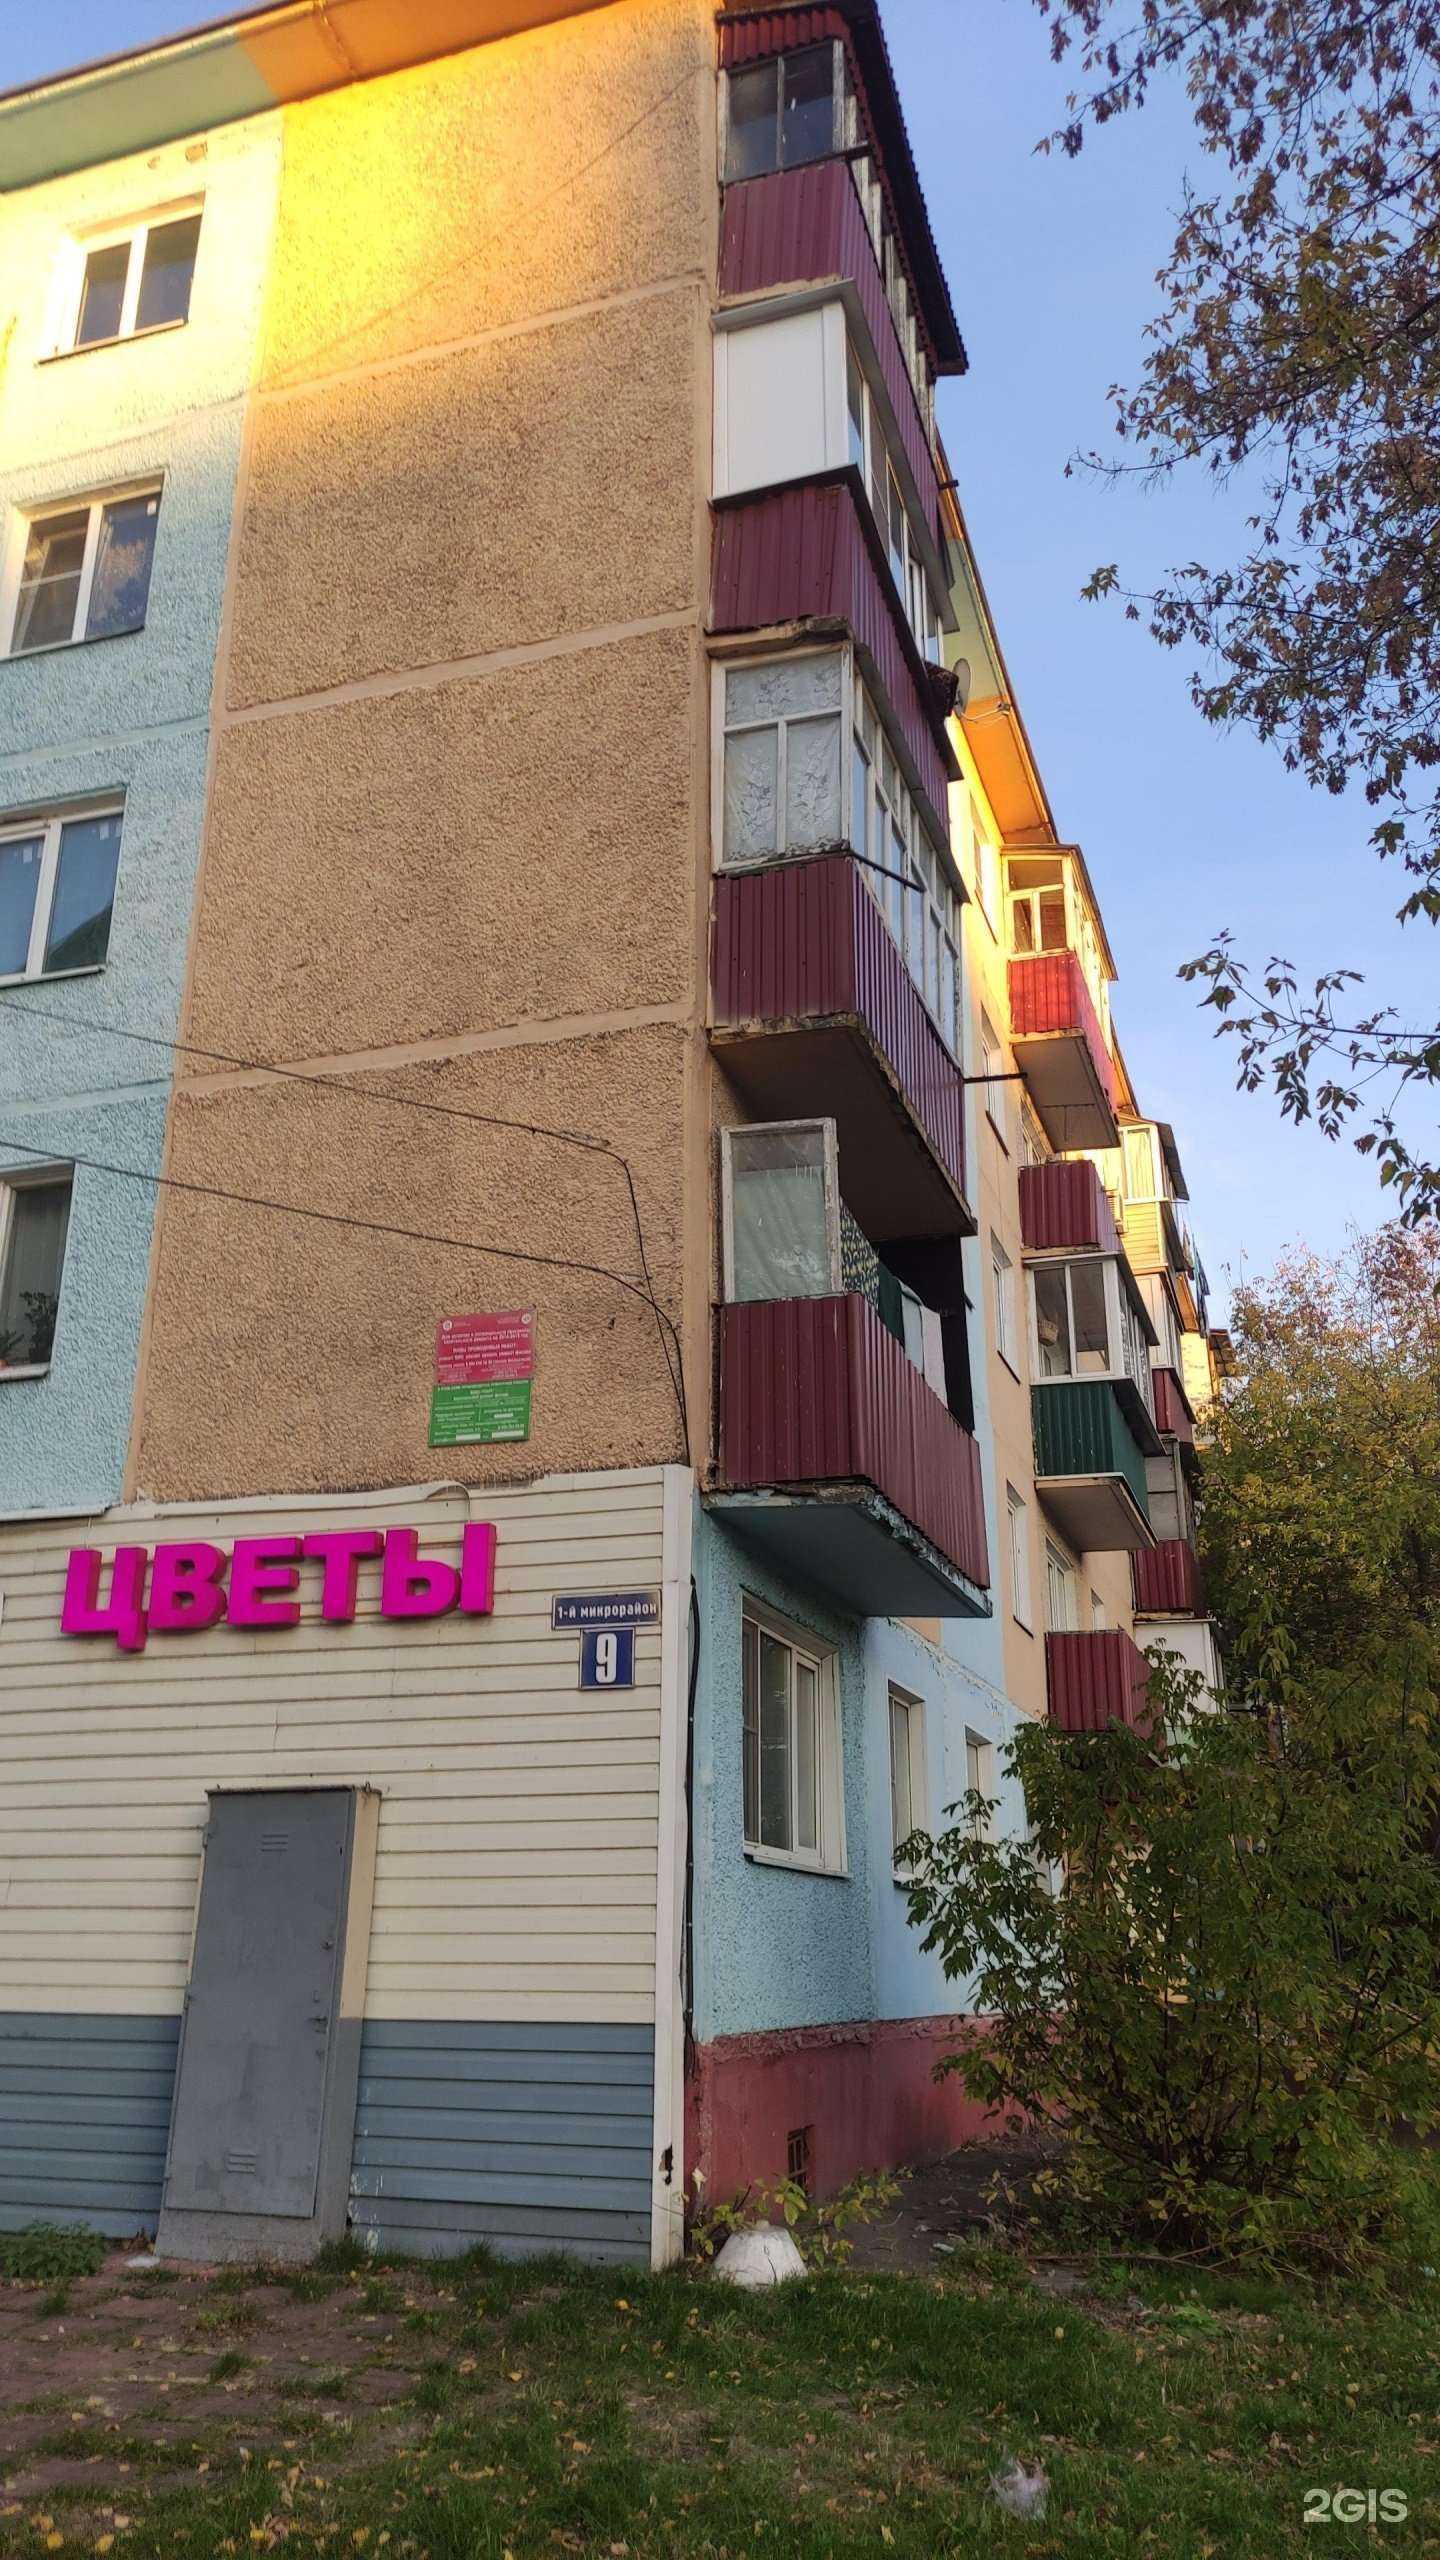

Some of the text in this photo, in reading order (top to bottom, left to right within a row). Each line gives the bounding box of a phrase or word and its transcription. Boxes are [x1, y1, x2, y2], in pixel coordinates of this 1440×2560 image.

[61, 1523, 496, 1652] ЦВЕТЫ
[558, 1602, 657, 1620] 1-й микрорайон
[595, 1633, 618, 1684] 9
